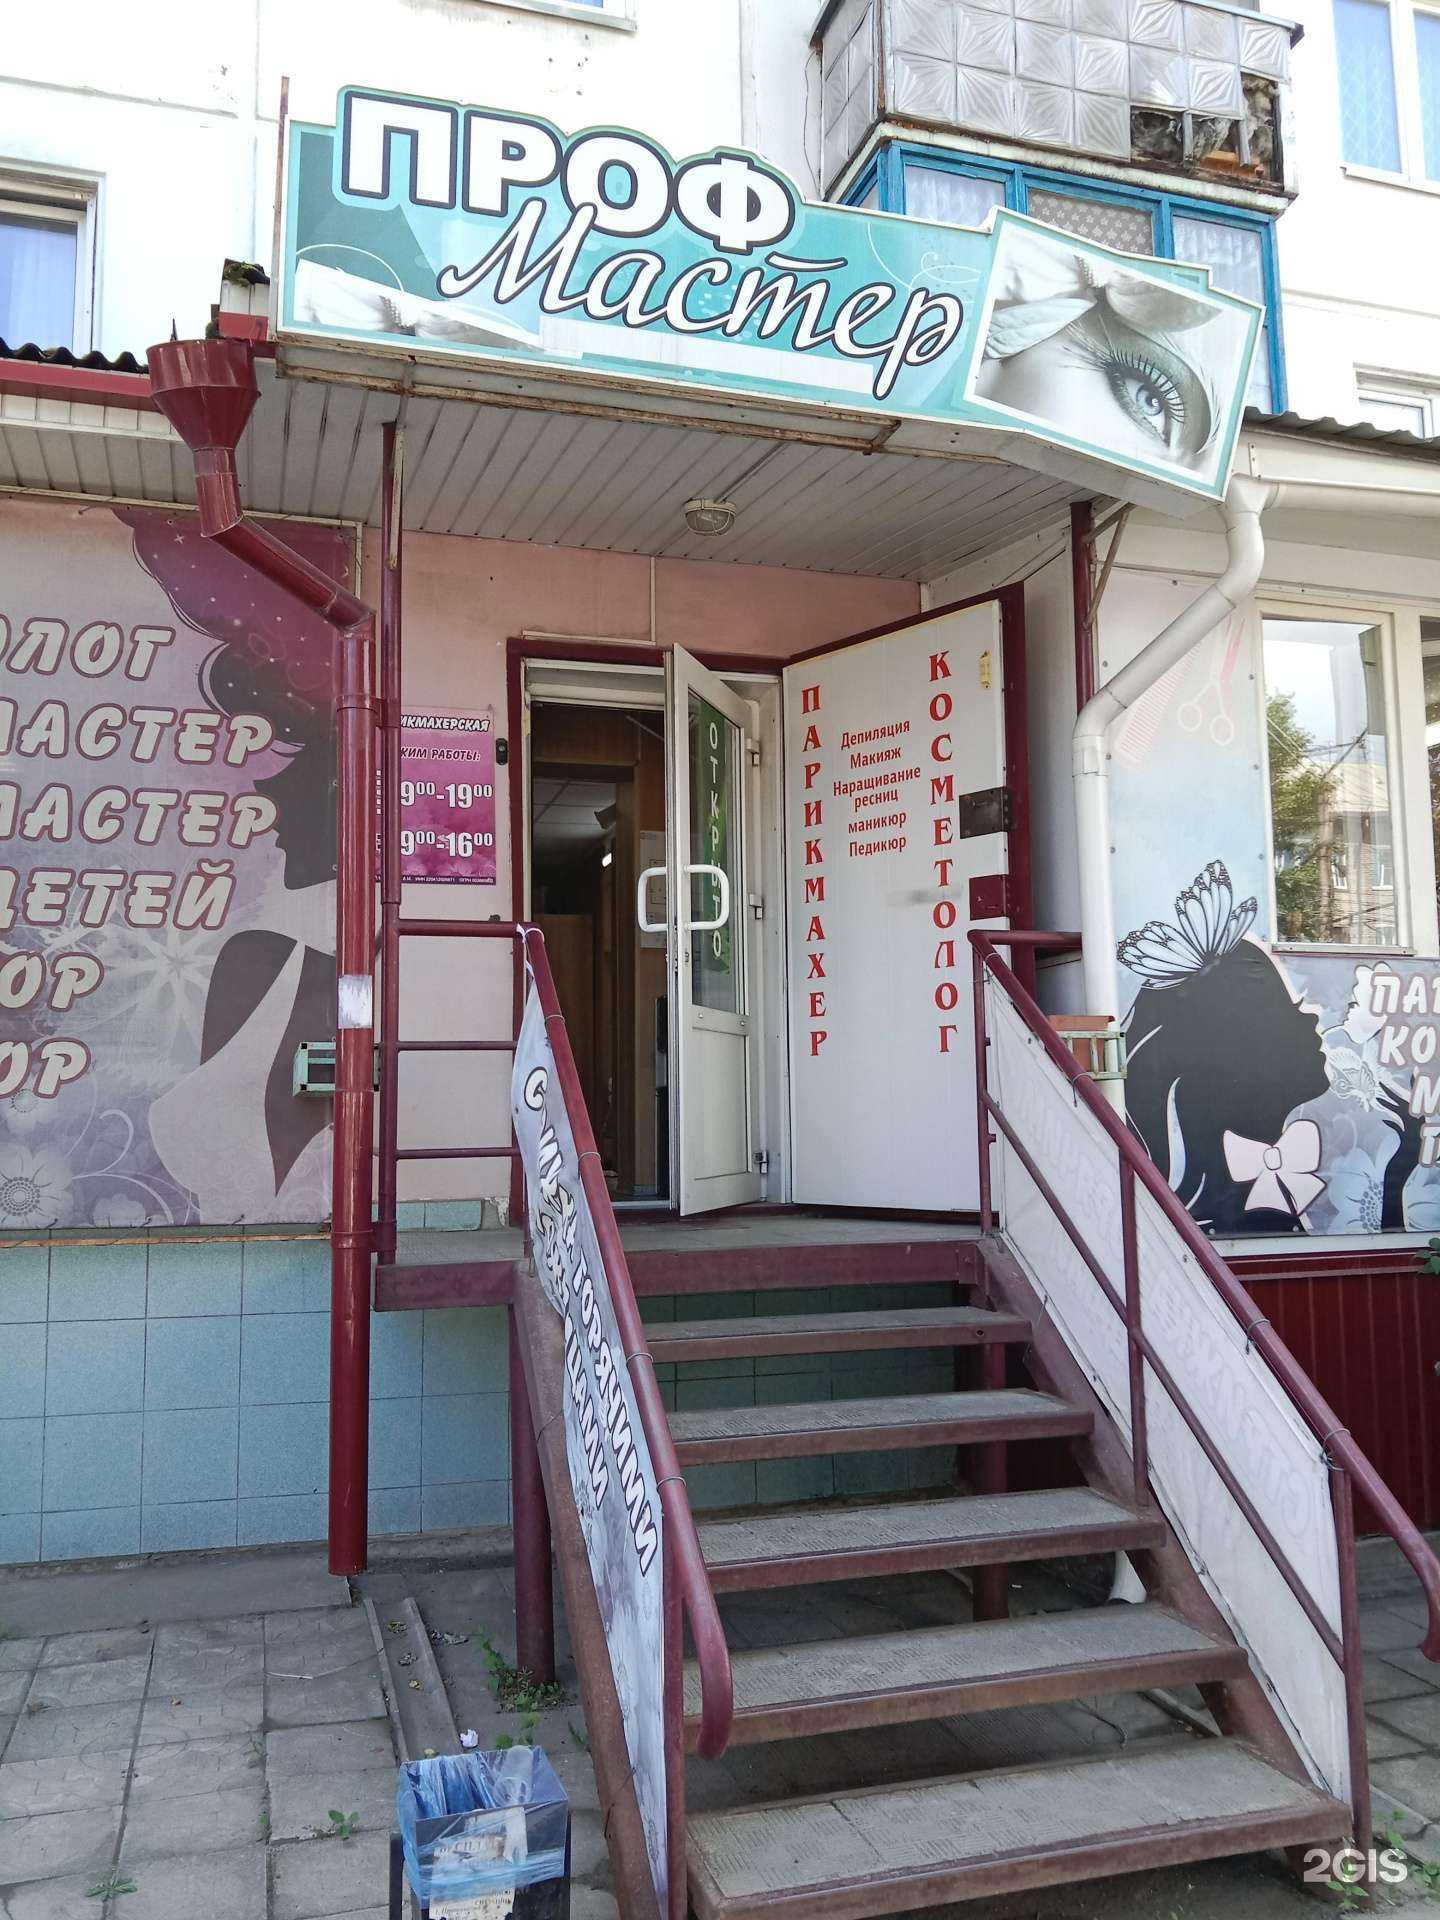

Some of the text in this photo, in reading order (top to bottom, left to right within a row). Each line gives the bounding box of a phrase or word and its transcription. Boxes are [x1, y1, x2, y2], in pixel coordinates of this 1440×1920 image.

[343, 90, 797, 254] ПРОФ
[438, 199, 964, 400] Мастер
[0, 614, 175, 681] ЛОГ
[841, 720, 911, 750] Депиляция
[432, 748, 480, 761] РАБОТЫ:
[850, 747, 901, 769] Макияж
[833, 767, 921, 797] Наращивание
[854, 788, 899, 812] ресниц
[848, 812, 907, 834] маникюр
[849, 837, 907, 857] Педикюр
[928, 650, 958, 1054] КОСМЕТОЛОГ
[801, 685, 828, 1057] ПАРИКМАХЕР
